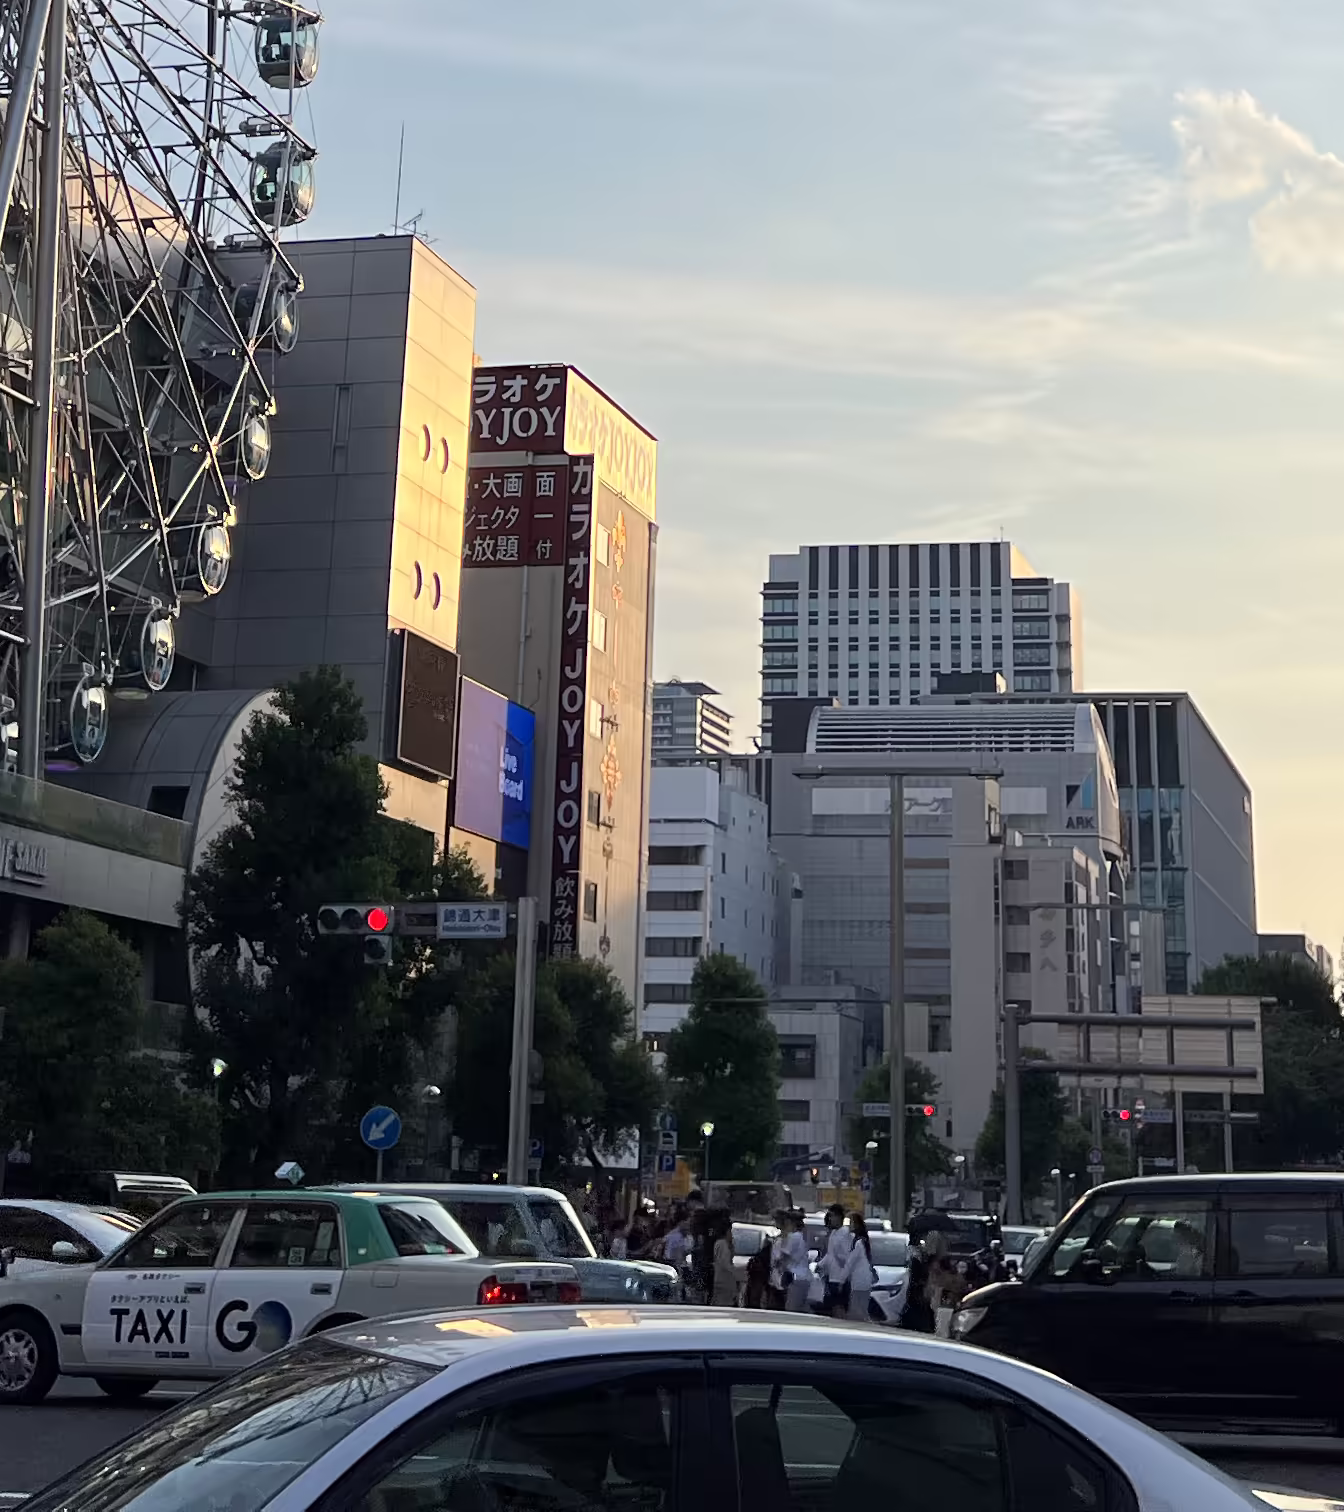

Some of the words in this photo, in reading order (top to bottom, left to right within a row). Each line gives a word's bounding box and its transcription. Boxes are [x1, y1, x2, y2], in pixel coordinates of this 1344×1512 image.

[472, 373, 561, 404] ラオケ
[470, 406, 562, 446] YJOY
[465, 471, 557, 500] ・大画面
[1065, 816, 1095, 830] ARK
[110, 1308, 187, 1343] TAXI
